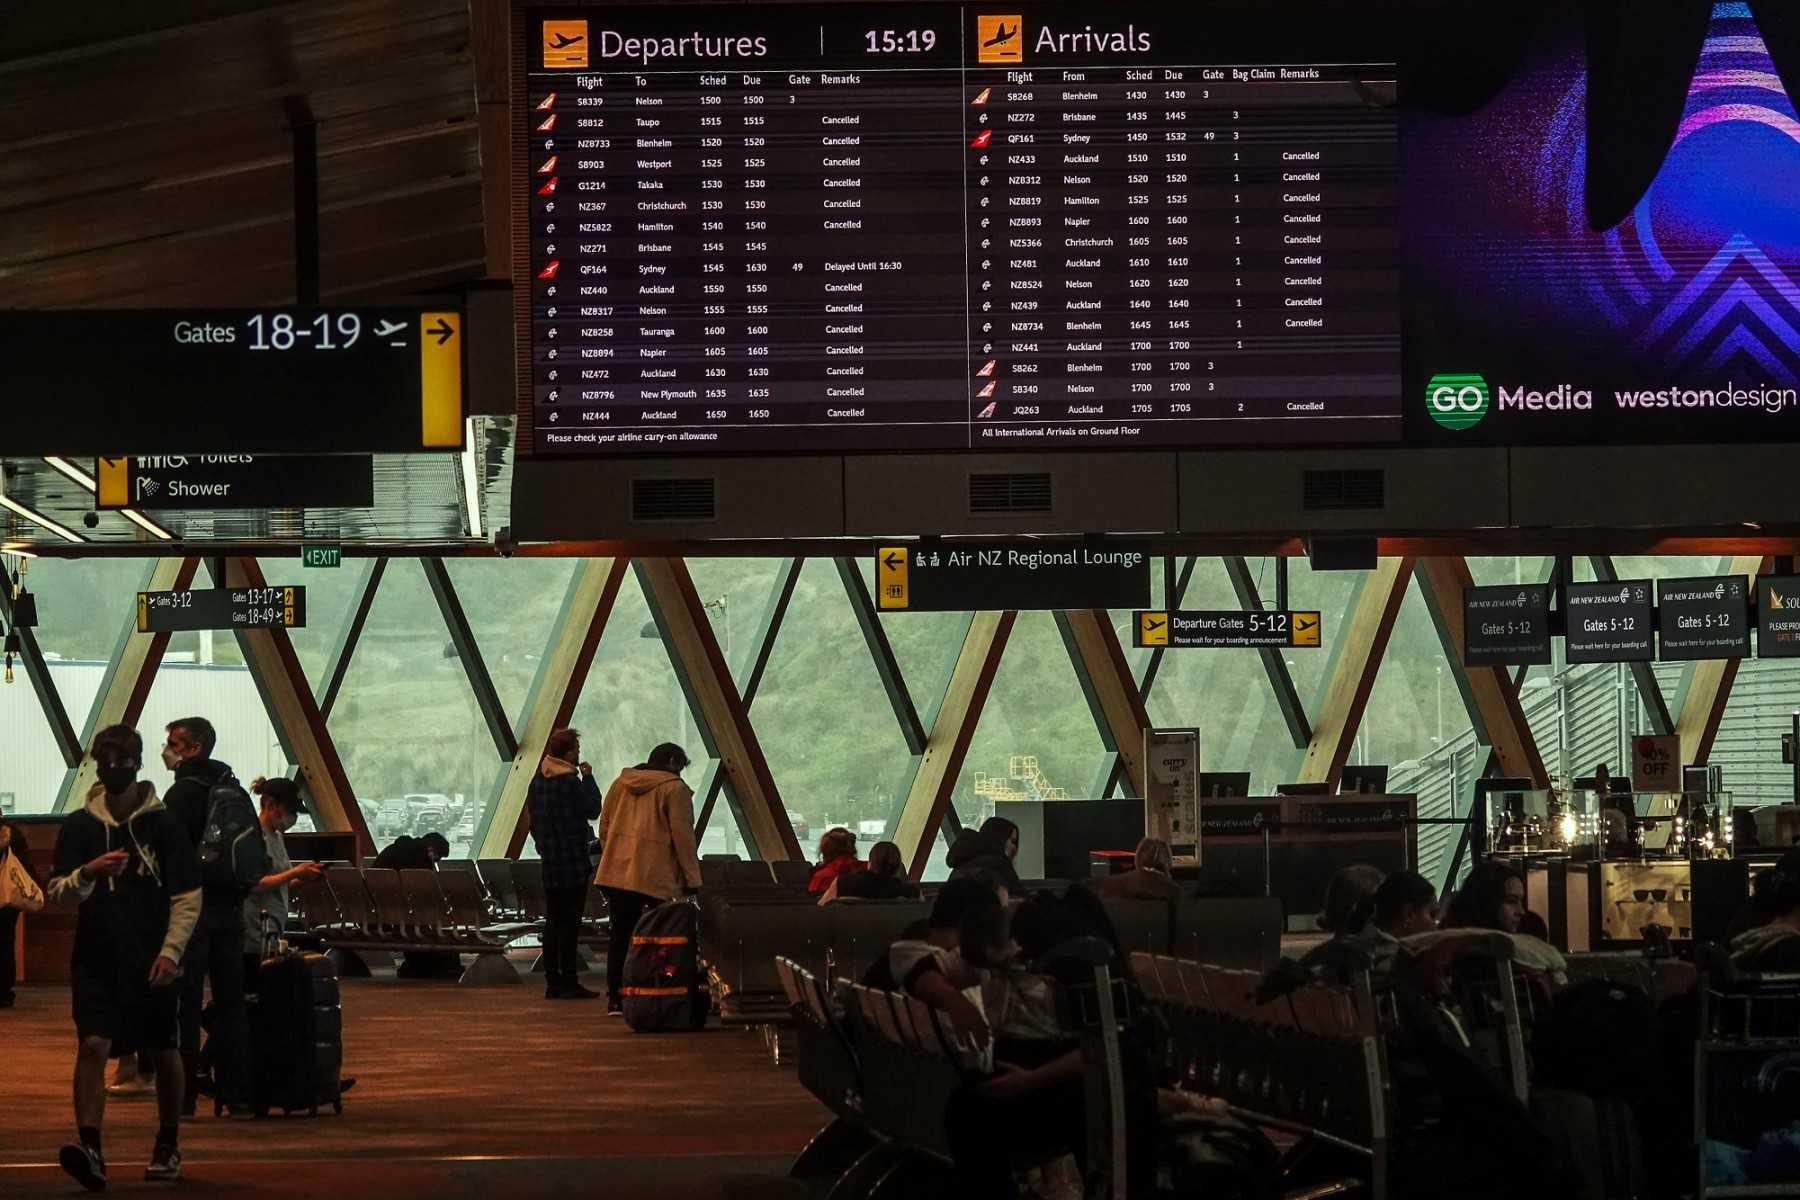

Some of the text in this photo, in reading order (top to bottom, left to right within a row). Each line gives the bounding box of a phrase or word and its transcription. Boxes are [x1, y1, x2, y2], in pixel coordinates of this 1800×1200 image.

[865, 30, 935, 52] 15:19
[1035, 25, 1150, 52] Arrivals
[602, 31, 766, 65] Departures
[577, 74, 860, 89] Flight To Sched Due Gate Remarks
[1008, 68, 1319, 84] Flight From Sched Due Gate Bag Claim Remarks
[577, 96, 764, 106] S8339 Nelson 1500 1500
[1008, 111, 1238, 122] NZ272 Brisbane 1435 1445 3
[1008, 135, 1034, 143] QF161
[1064, 134, 1090, 144] Sydney
[1127, 133, 1147, 141] 1450
[1204, 132, 1214, 140] 49
[1234, 132, 1239, 140] 3
[1009, 155, 1035, 163] NZ433
[1064, 154, 1099, 163] Auckland
[1128, 154, 1148, 162] 1510
[1283, 152, 1319, 160] Cancelled
[578, 179, 860, 190] G1214 Takaka 1530 1530 Cancelled
[579, 203, 606, 211] NZ367
[638, 201, 686, 210] Christchurch
[702, 201, 723, 209] 1530
[745, 201, 765, 209] 1530
[580, 244, 606, 253] NZ271
[639, 244, 671, 252] Brisbane
[703, 243, 724, 251] 1545
[580, 266, 607, 275] QF164
[639, 264, 666, 275] Sydney
[704, 264, 724, 272] 1545
[746, 264, 767, 272] 1630
[792, 263, 803, 271] 49
[825, 263, 855, 272] Delayed
[1011, 302, 1038, 310] NZ439
[1066, 300, 1101, 309] Auckland
[1130, 300, 1151, 308] 1640
[1169, 300, 1189, 308] 1640
[1285, 298, 1322, 306] Cancelled
[175, 314, 360, 349] Gates 18-19
[1067, 342, 1102, 351] Auckland
[1131, 342, 1151, 350] 1700
[1169, 340, 1190, 349] 1700
[582, 367, 863, 378] NZ472 Auckland 1630 1630 Cancelled
[1432, 385, 1591, 411] GO Media
[1615, 381, 1796, 412] westondesign
[583, 412, 609, 420] NZ444
[642, 411, 677, 419] Auckland
[749, 410, 769, 418] 1650
[827, 409, 864, 417] Cancelled
[1013, 406, 1039, 415] JQ263
[1067, 405, 1103, 415] Auckland
[1171, 404, 1191, 412] 1705
[1238, 403, 1243, 411] 2
[1287, 402, 1324, 410] Cancelled
[547, 434, 572, 442] Please
[598, 435, 615, 443] your
[618, 433, 642, 441] airline
[645, 434, 677, 442] carry-on
[996, 428, 1044, 436] International
[1091, 427, 1118, 435] Ground
[169, 481, 230, 496] Shower
[313, 550, 338, 564] EXIT
[949, 549, 1141, 569] Air NZ Regional Lounge
[157, 592, 191, 607] Gates 3-12
[233, 588, 273, 604] Gates 13-17
[233, 608, 273, 623] Gates 18-49
[1678, 614, 1729, 628] Gates 5-12
[1174, 615, 1286, 631] Departure Gates 5-12
[1584, 618, 1633, 631] Gates 5-12
[1789, 622, 1800, 630] PRO
[1227, 637, 1249, 645] boarding
